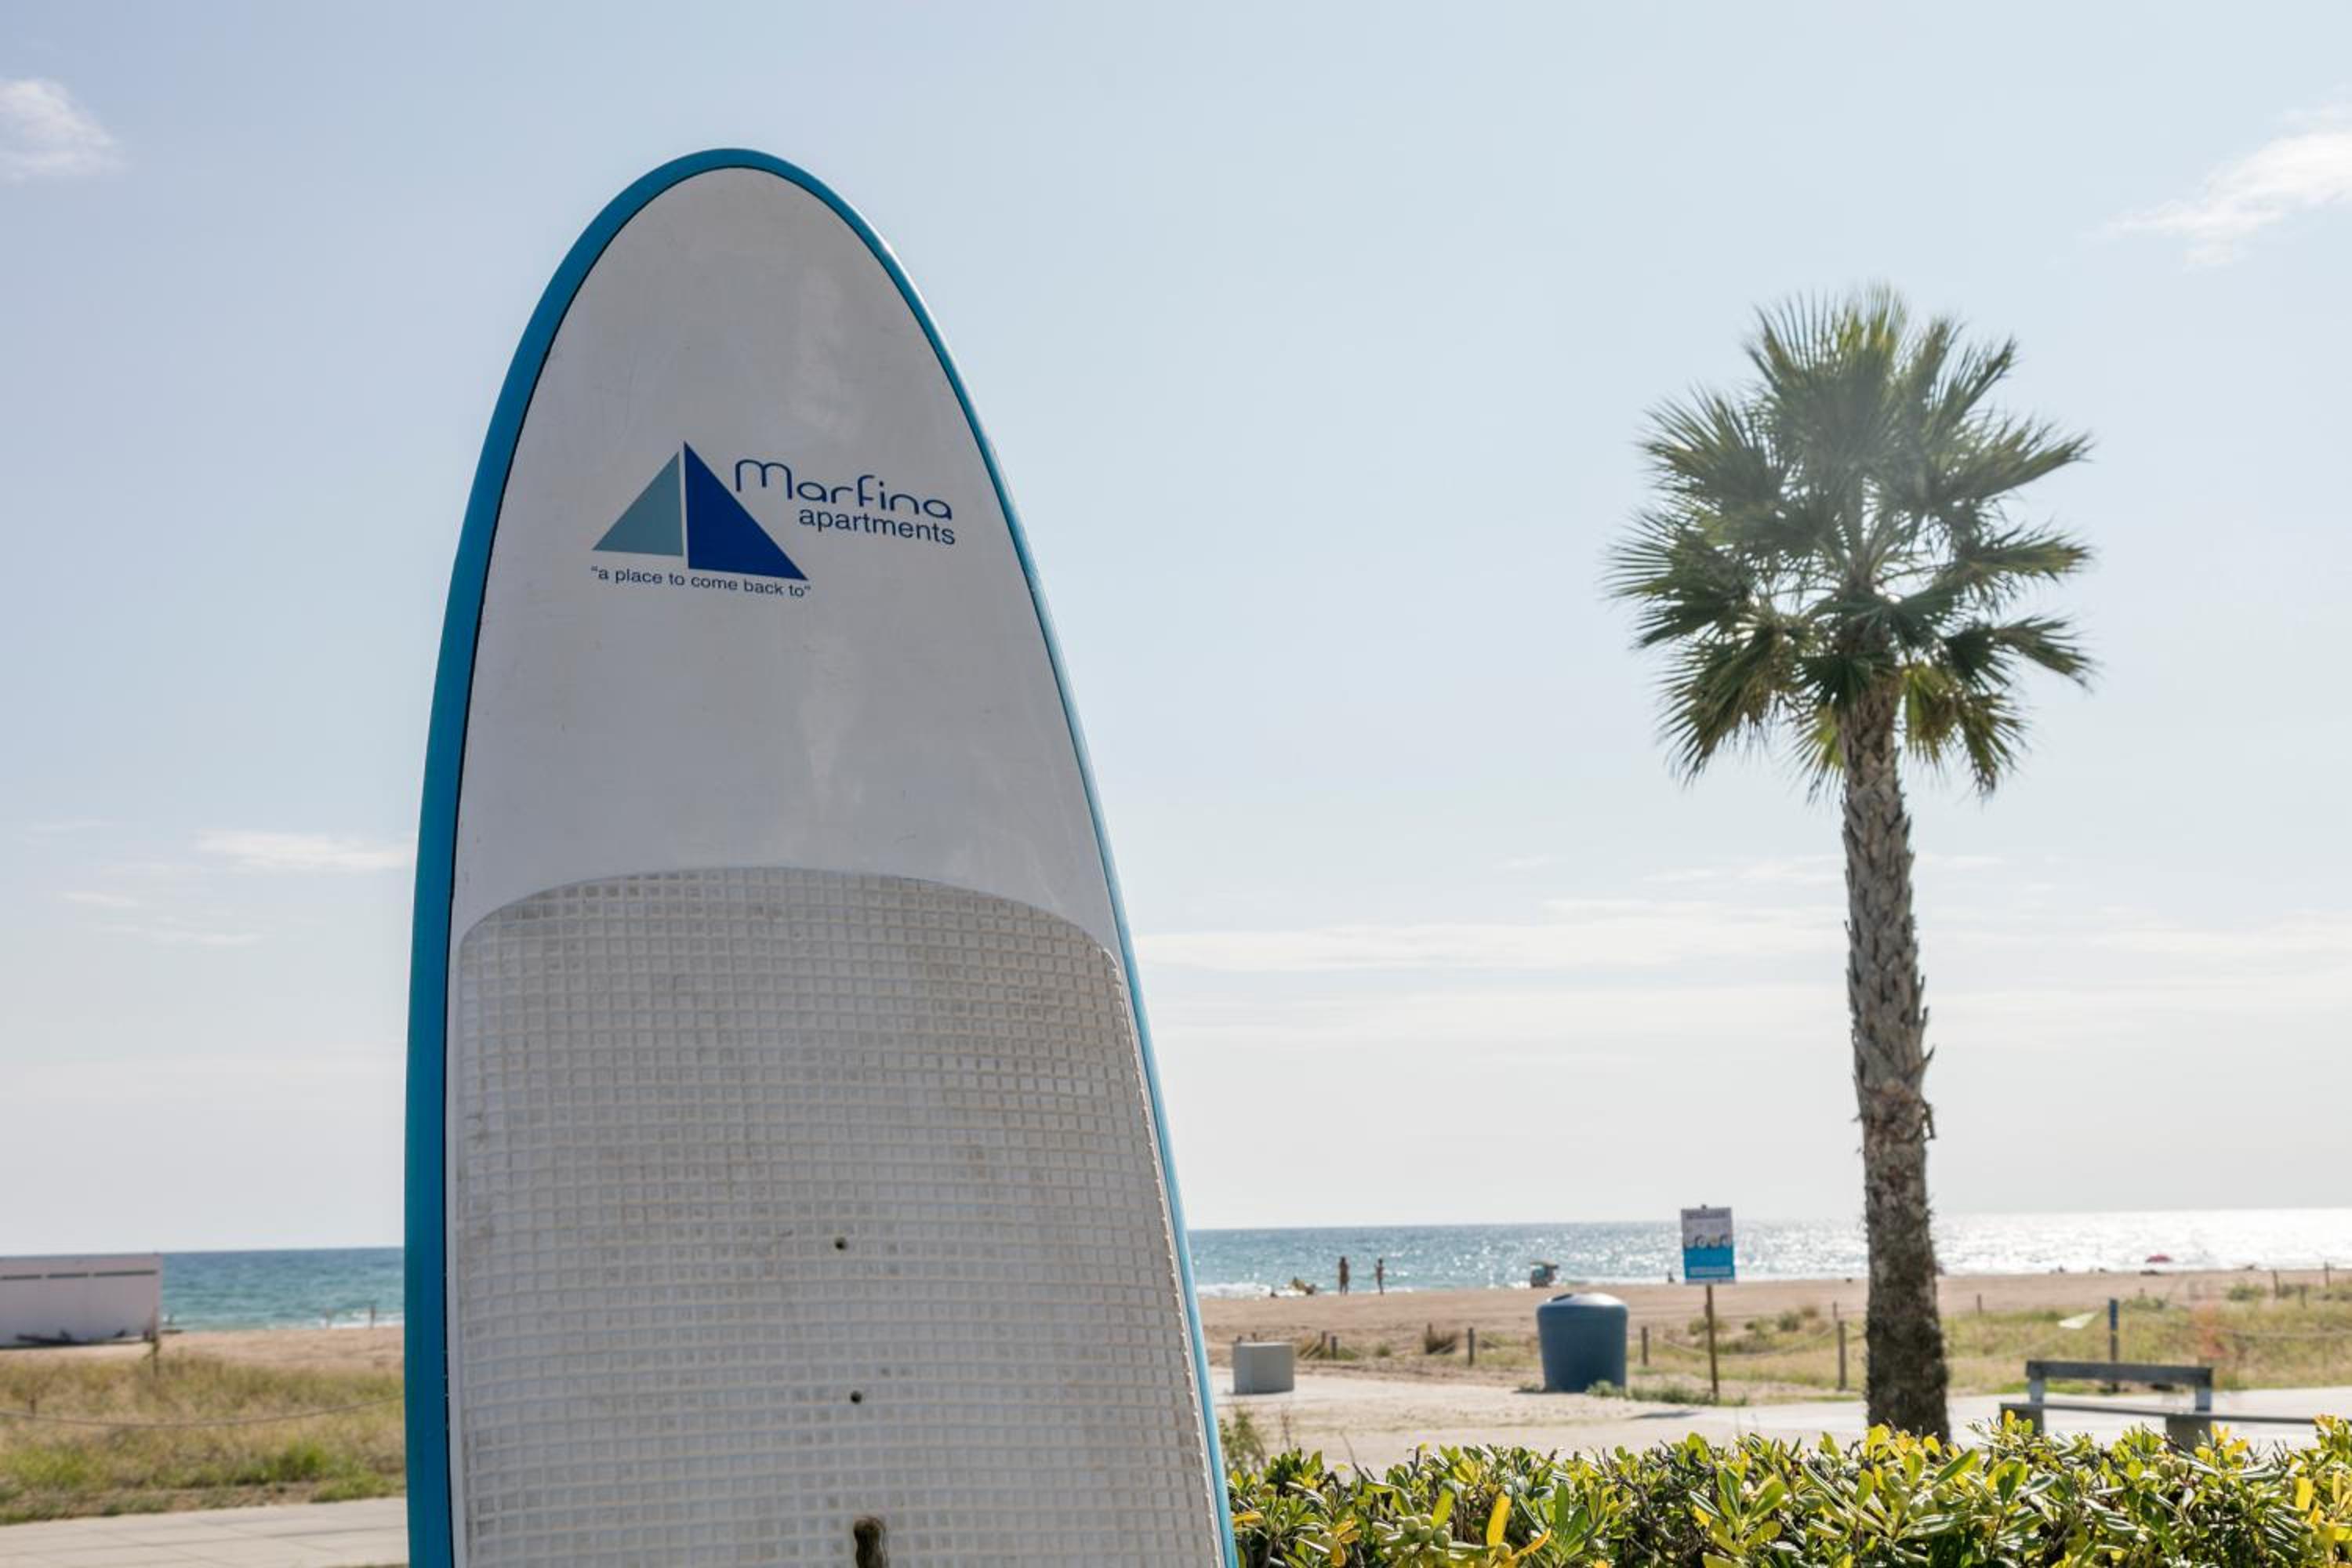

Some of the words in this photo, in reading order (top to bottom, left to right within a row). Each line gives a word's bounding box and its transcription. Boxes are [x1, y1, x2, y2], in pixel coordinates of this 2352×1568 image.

[798, 508, 956, 546] apartments
[615, 568, 663, 584] place
[669, 572, 686, 586] to
[691, 575, 739, 591] come
[743, 579, 785, 596] back
